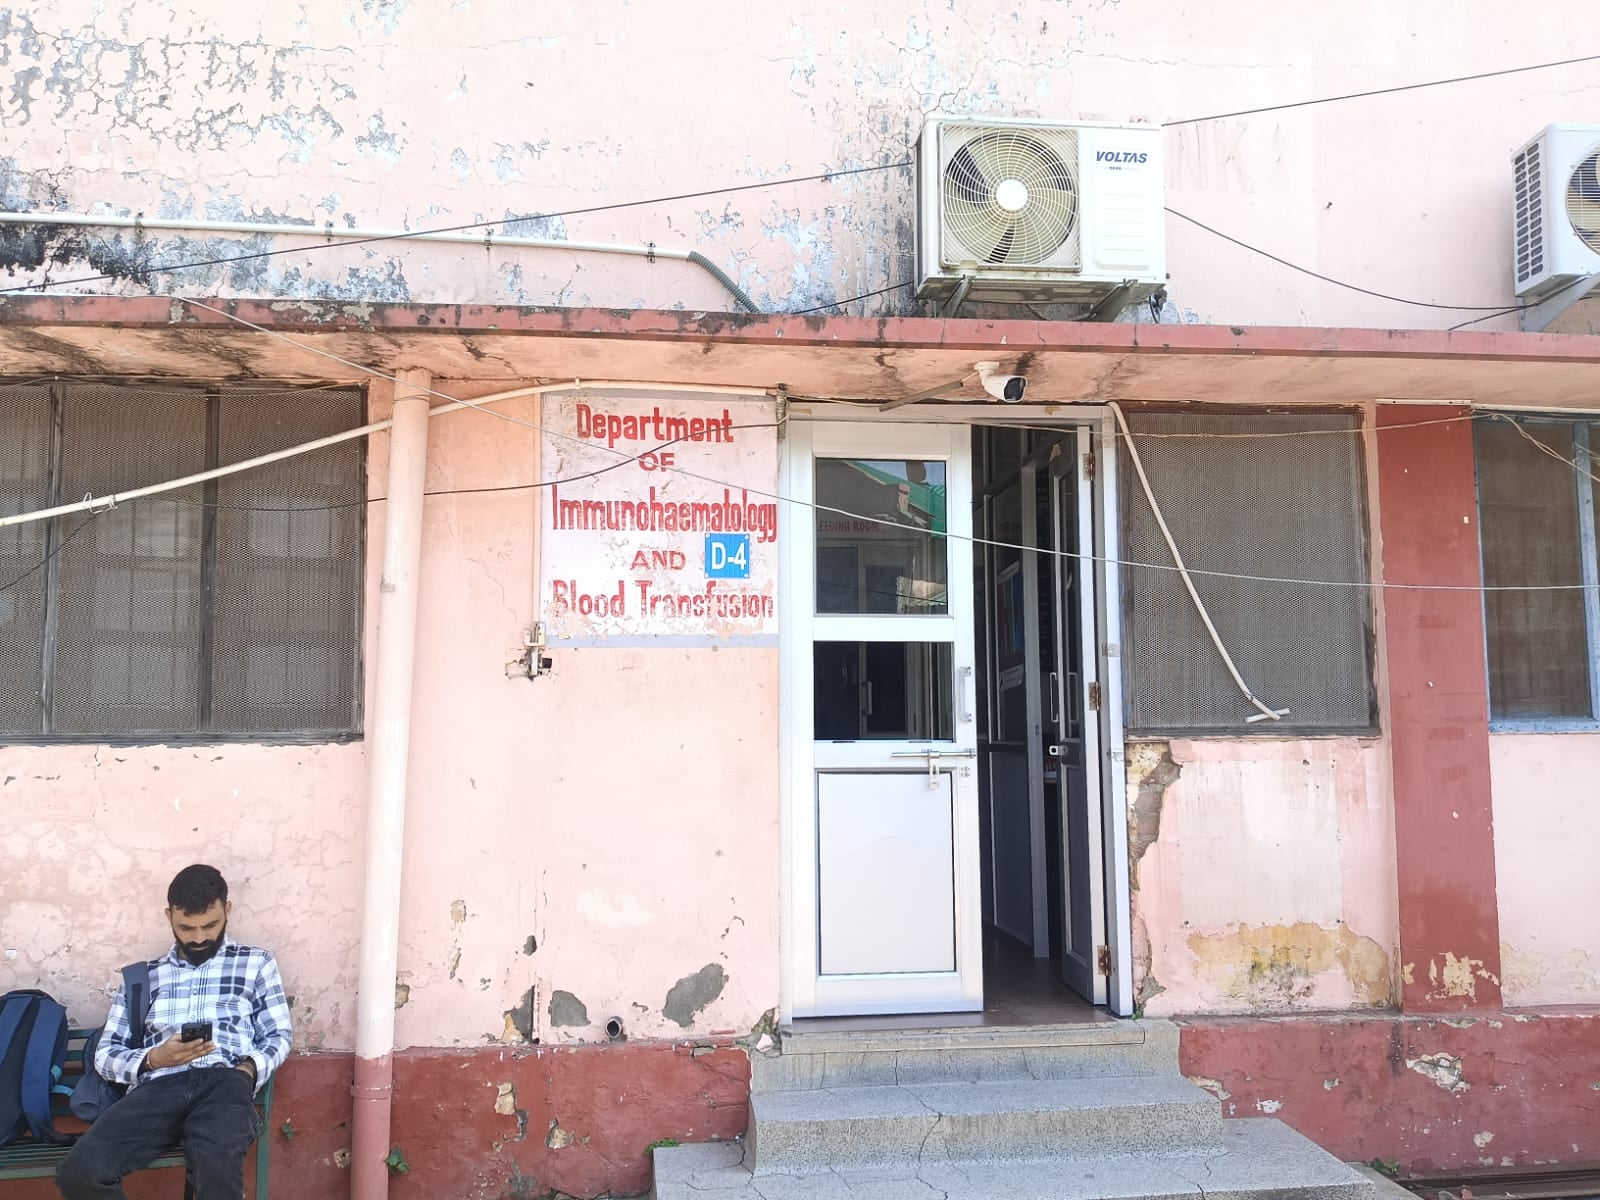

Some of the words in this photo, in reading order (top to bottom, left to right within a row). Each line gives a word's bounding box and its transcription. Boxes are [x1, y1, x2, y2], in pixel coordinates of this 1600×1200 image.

[1096, 151, 1148, 163] VOLTAS
[576, 403, 734, 448] Department
[639, 452, 675, 472] OF
[551, 484, 777, 543] Immunohaematology
[630, 549, 687, 570] AND
[711, 541, 747, 570] D-4
[552, 580, 625, 617] Blood
[635, 580, 774, 618] Transfusion
